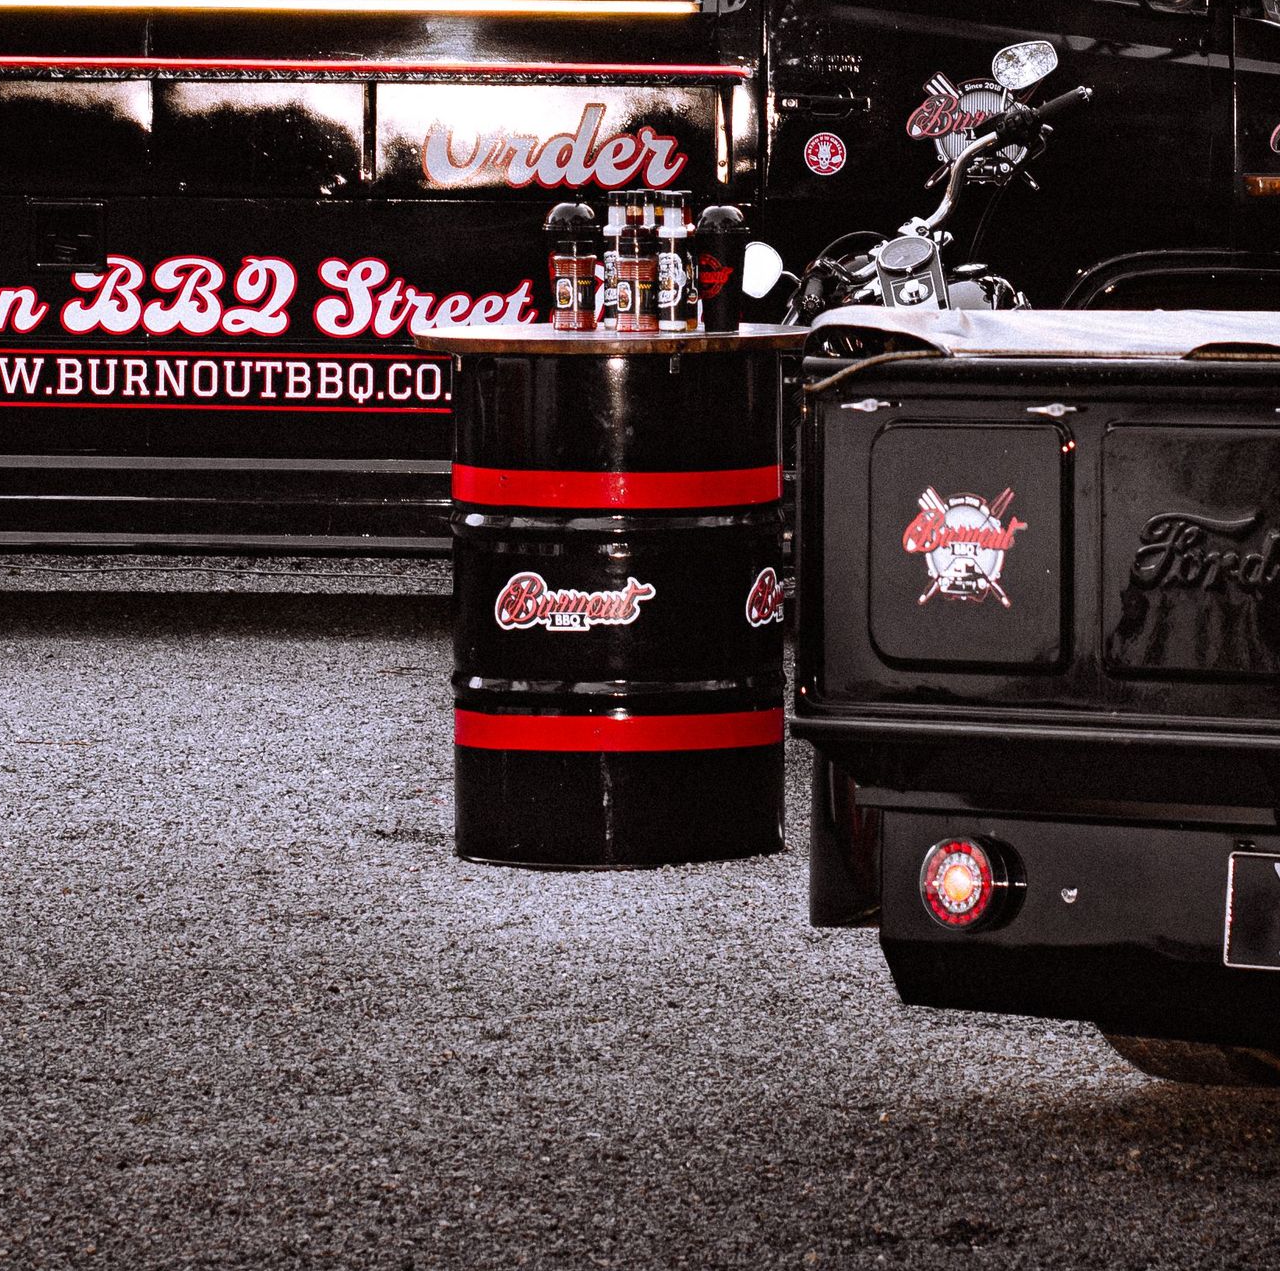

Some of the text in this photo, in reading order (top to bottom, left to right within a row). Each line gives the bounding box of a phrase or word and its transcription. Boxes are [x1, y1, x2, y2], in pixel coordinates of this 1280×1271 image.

[965, 81, 1002, 92] Since 2018
[420, 103, 688, 189] Order
[313, 257, 540, 337] Street
[1134, 512, 1280, 593] Ford
[497, 574, 654, 625] Burnout
[555, 614, 580, 628] BBQ
